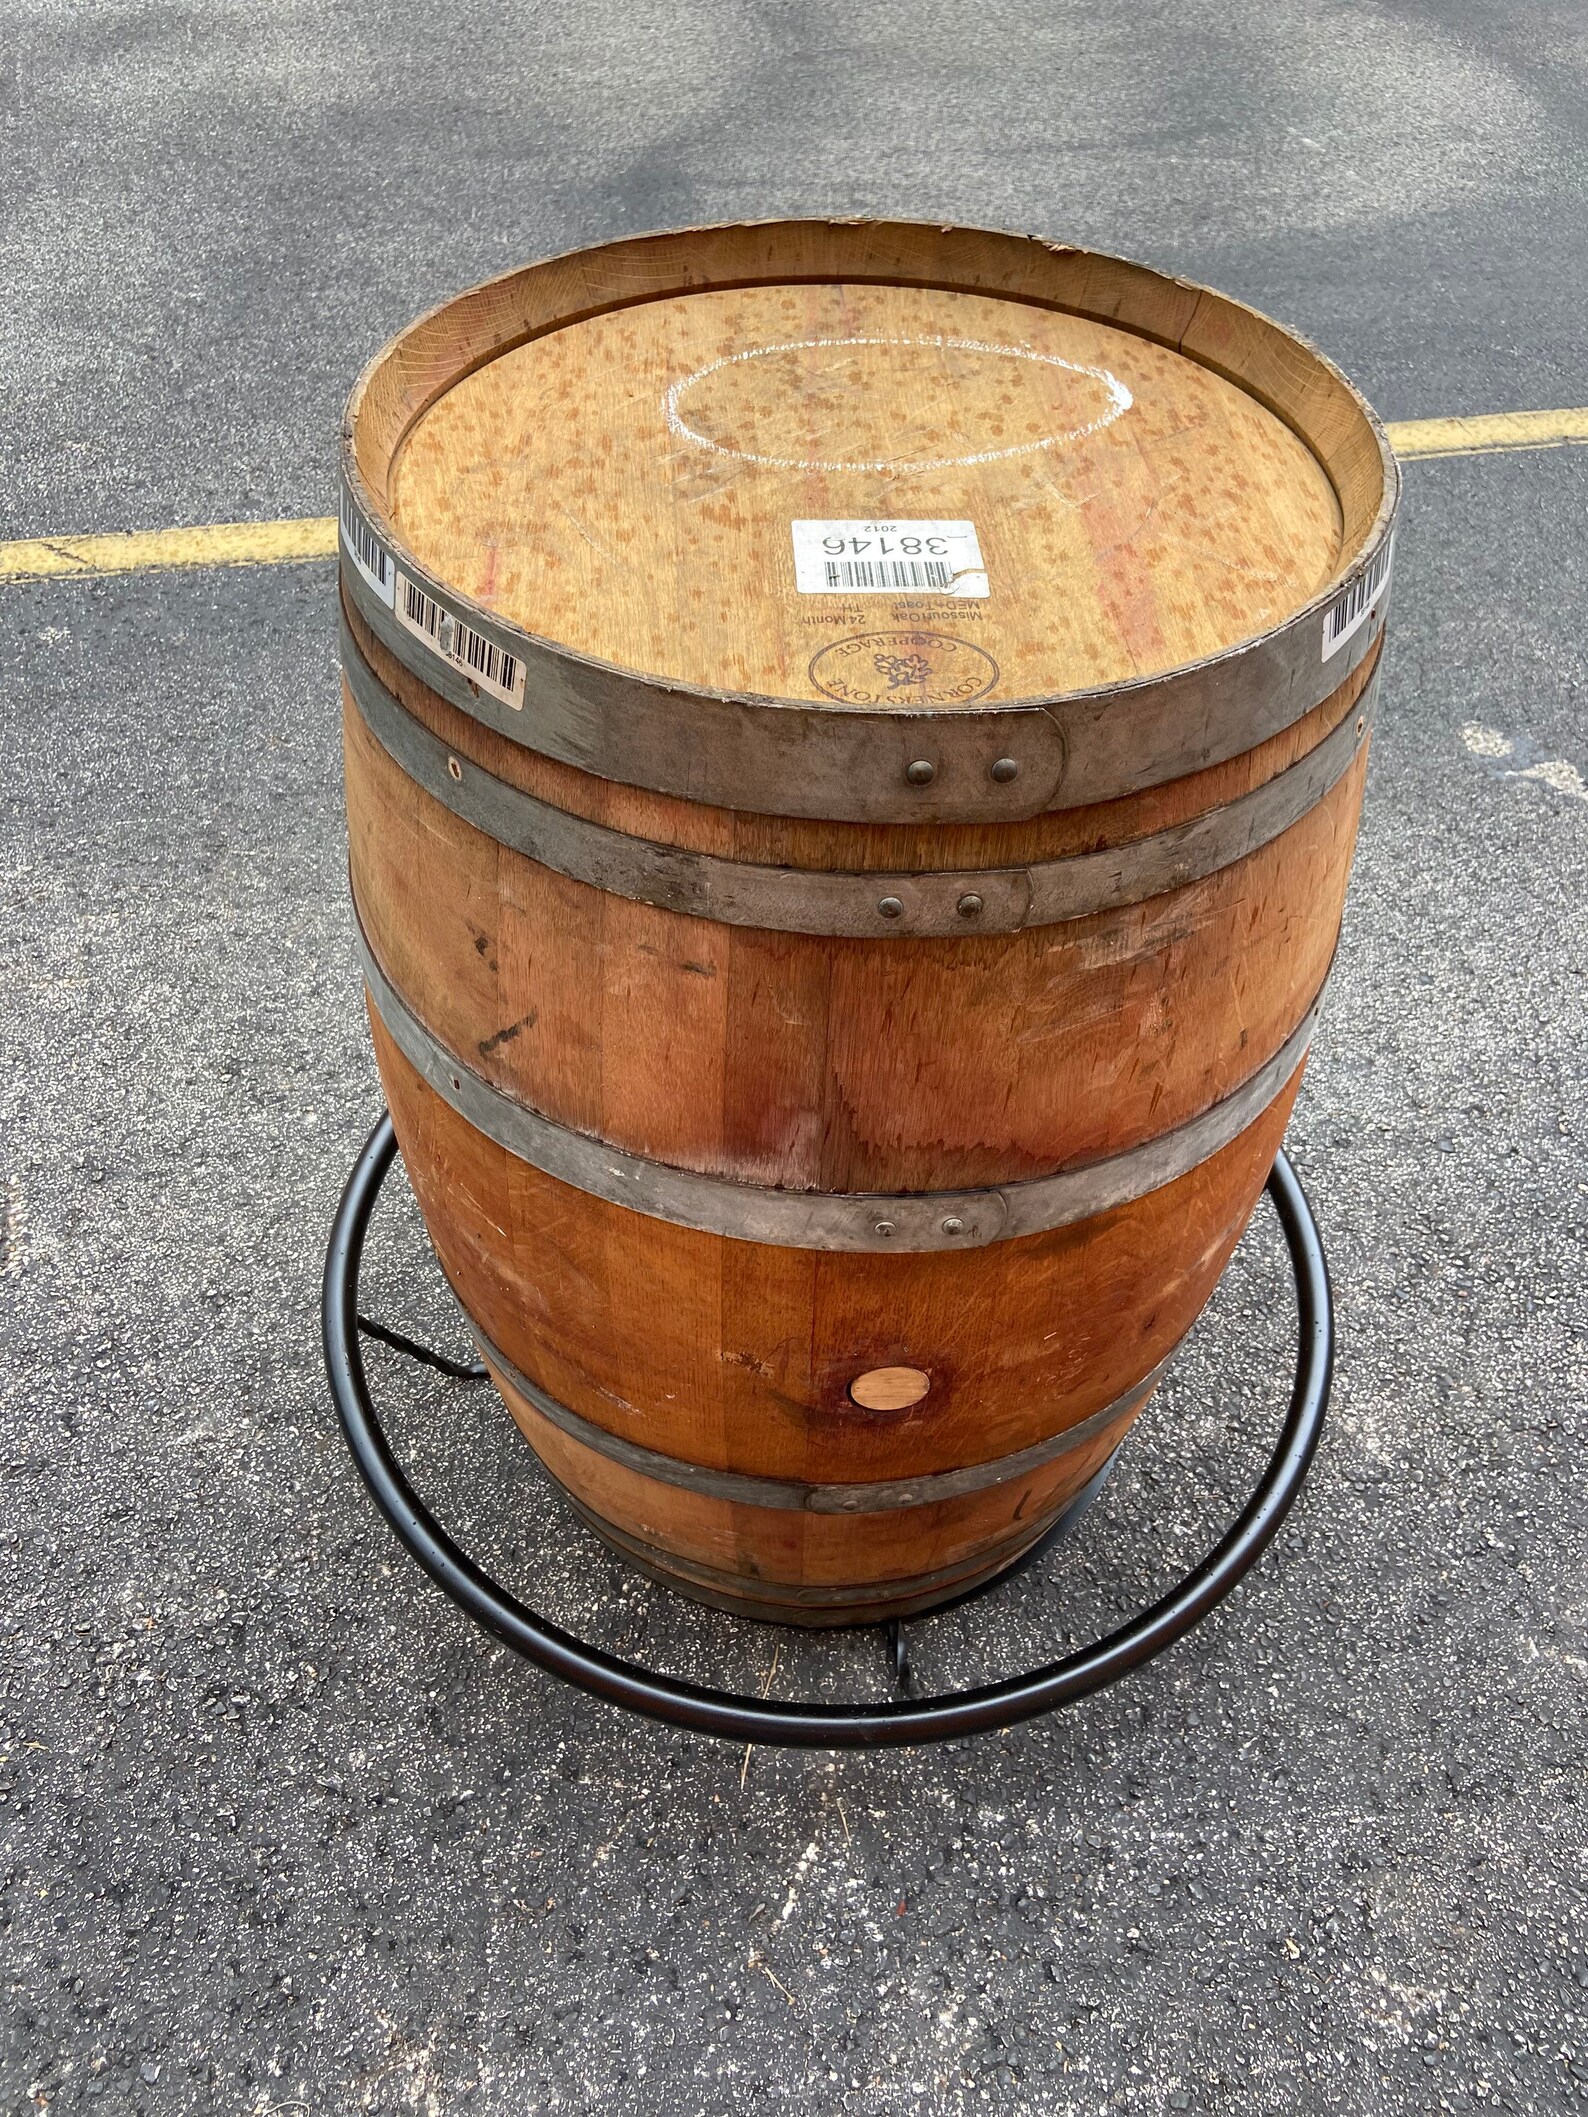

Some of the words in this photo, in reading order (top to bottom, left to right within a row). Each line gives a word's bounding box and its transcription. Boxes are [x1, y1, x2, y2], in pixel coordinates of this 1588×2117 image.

[864, 525, 897, 533] 2012
[822, 536, 949, 556] 38146
[842, 603, 864, 613] TH
[802, 615, 846, 626] Month
[849, 614, 866, 625] 24
[890, 612, 920, 623] Oak
[922, 611, 983, 623] Missouri
[835, 637, 957, 657] COOPERAGE
